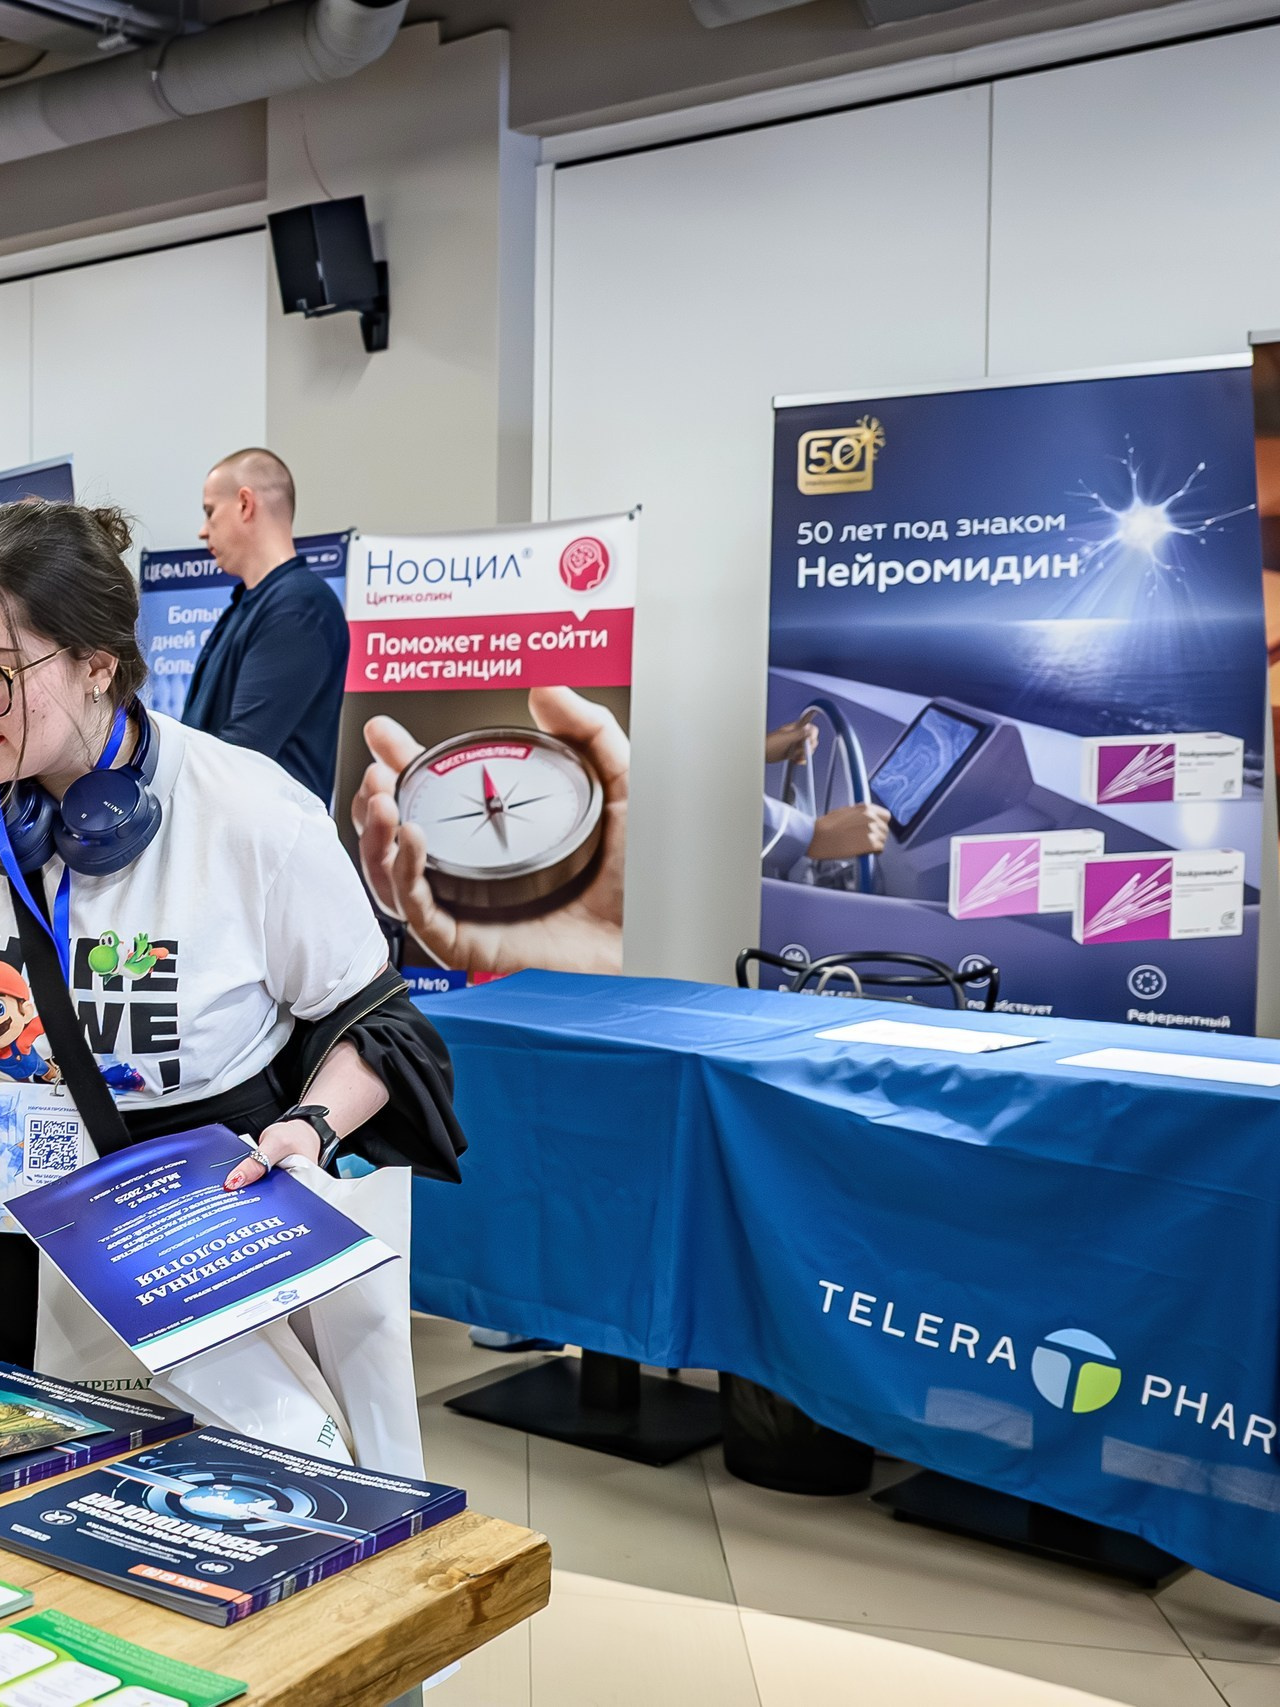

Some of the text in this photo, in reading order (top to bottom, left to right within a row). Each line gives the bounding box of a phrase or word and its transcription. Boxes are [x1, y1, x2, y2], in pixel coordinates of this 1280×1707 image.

[808, 437, 861, 475] 50
[797, 513, 1066, 545] 50 лет под знаком
[797, 552, 1080, 593] Нейромидин
[366, 590, 453, 606] Цитиколин
[150, 629, 195, 652] дней
[366, 624, 608, 656] Поможет не сойти
[365, 658, 522, 683] с дистанции
[1126, 1008, 1231, 1029] Референтный
[112, 1186, 145, 1203] 2025
[141, 1171, 181, 1190] МАРТ
[126, 1200, 138, 1208] 2
[134, 1190, 161, 1204] Том
[133, 1215, 285, 1287] НЕВРОЛОГИЯ
[135, 1223, 312, 1305] КОМОРБИДНАЯ
[819, 1279, 1278, 1455] TELERA PHAR
[197, 1433, 430, 1497] ОБЩЕРОССИЙСКОЙ ОБЩЕСТВЕННОЙ ОРГАНИЗАЦИИ
[268, 1449, 341, 1472] РЕВМАТОЛОГОВ
[64, 1501, 258, 1561] НАУЧНО-ПРАКТИЧЕСКАЯ
[77, 1492, 280, 1555] РЕВМАТОЛОГИЯ
